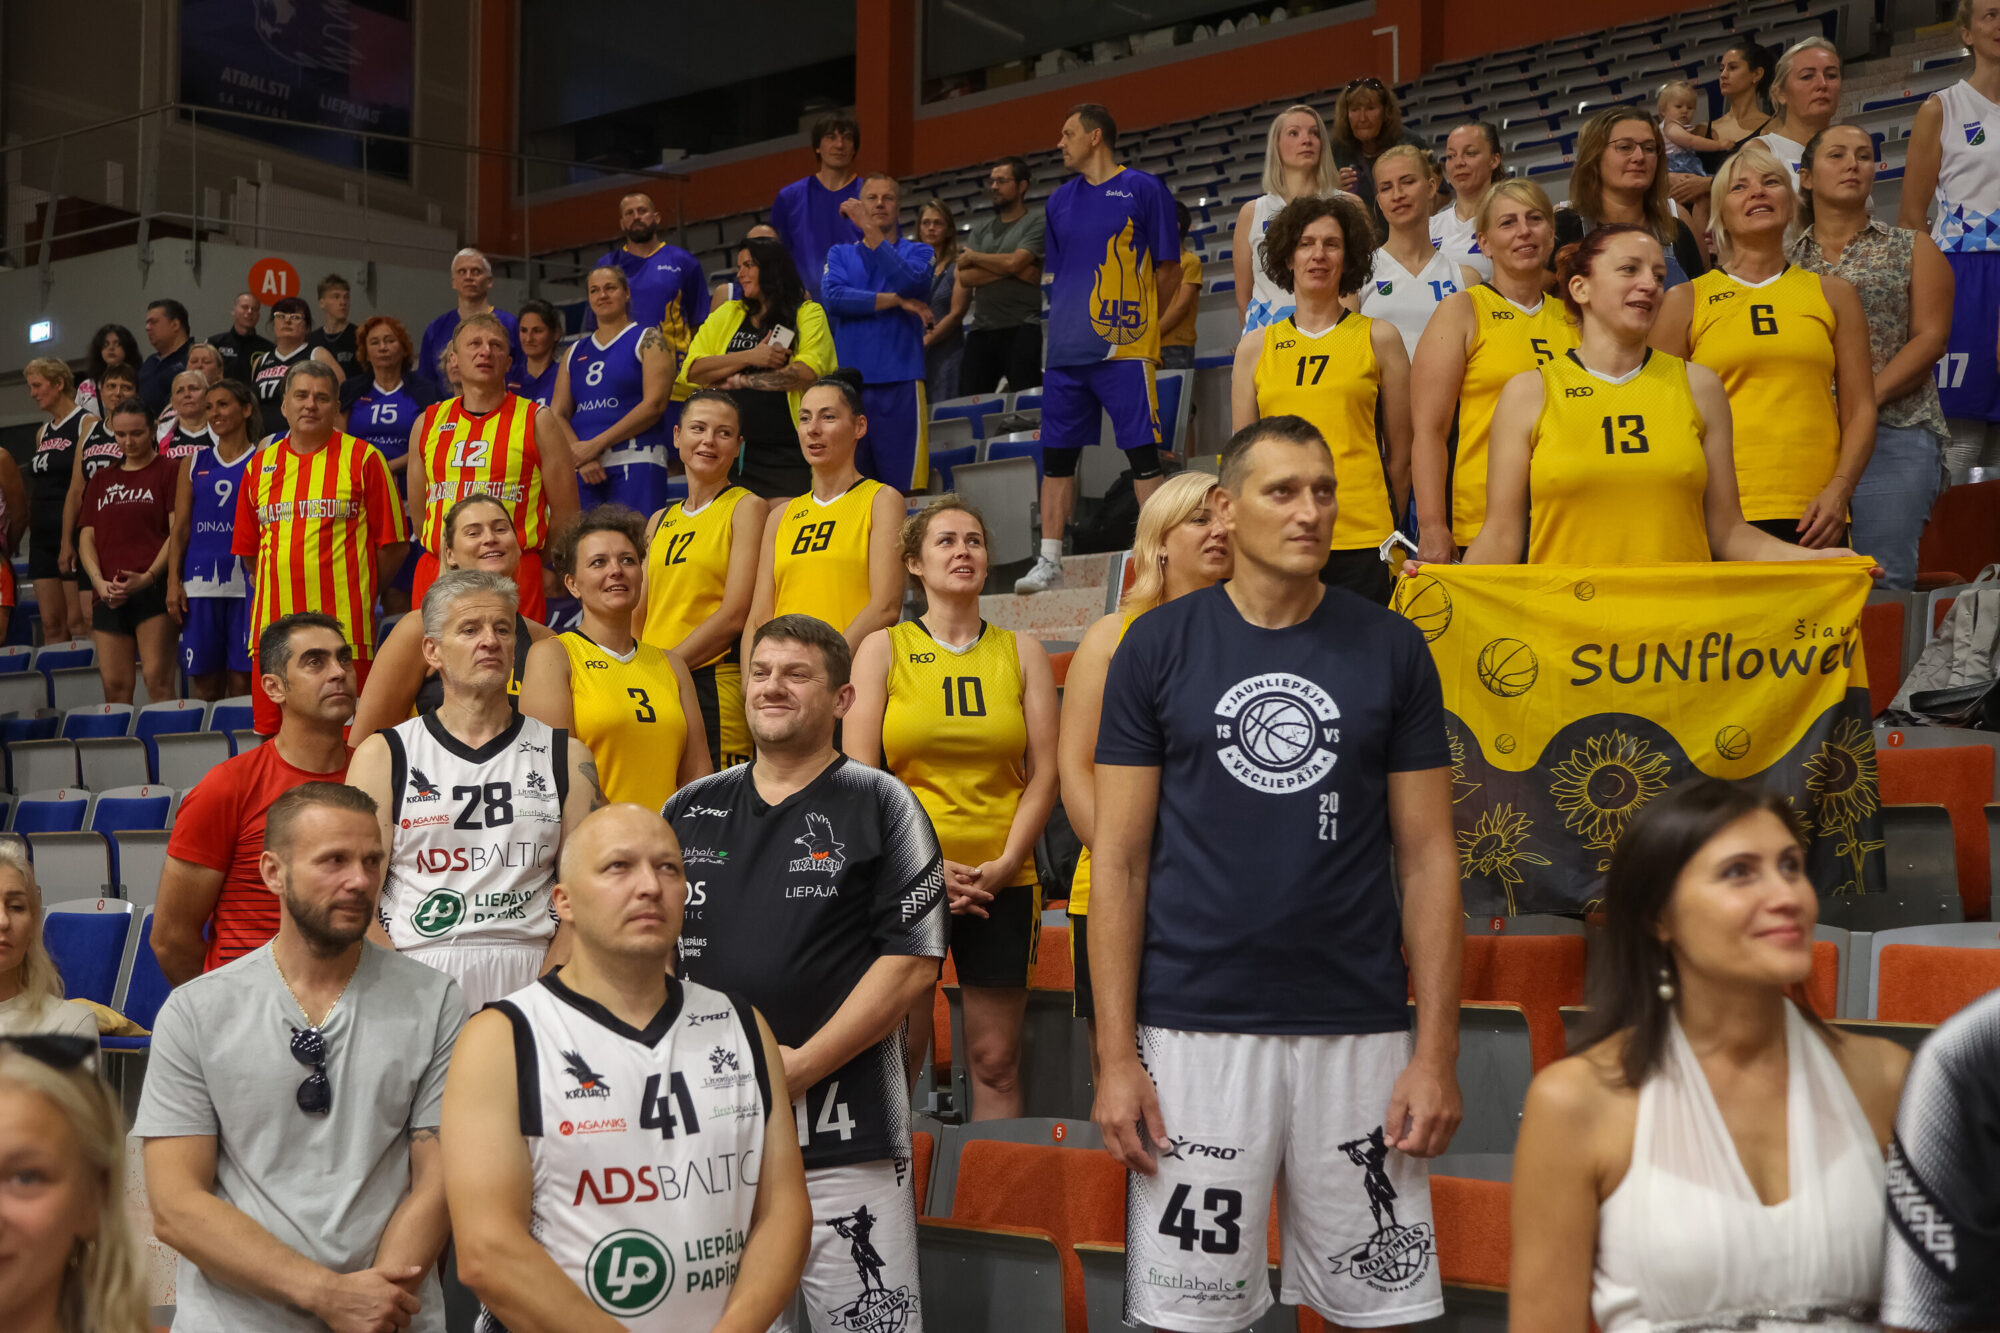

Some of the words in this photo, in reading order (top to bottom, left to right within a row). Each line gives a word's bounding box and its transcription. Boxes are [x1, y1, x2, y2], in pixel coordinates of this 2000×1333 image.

[262, 269, 287, 296] A1
[1098, 299, 1141, 329] 45
[1750, 304, 1778, 335] 6
[1530, 338, 1554, 366] 5
[585, 360, 606, 386] 8
[1296, 355, 1330, 386] 17
[1936, 353, 1969, 388] 17
[258, 380, 280, 400] 17
[370, 403, 398, 425] 15
[576, 397, 619, 413] INAMO
[1601, 415, 1650, 454] 13
[32, 453, 50, 473] 14
[451, 440, 489, 467] 12
[98, 488, 154, 511] LATVIJA
[214, 479, 233, 507] 9
[197, 521, 236, 533] DINAM
[791, 520, 836, 555] 69
[664, 531, 696, 566] 12
[186, 647, 194, 669] 9
[627, 687, 657, 723] 3
[942, 676, 987, 716] 10
[1216, 724, 1232, 739] VS
[1323, 728, 1340, 743] VS
[1233, 759, 1323, 788] VECLIEPĀJA
[452, 781, 514, 830] 28
[1319, 792, 1339, 813] 20
[412, 814, 449, 826] AGAMIKS
[1318, 814, 1337, 840] 21
[785, 886, 839, 899] LIEPĀJA
[639, 1071, 701, 1141] 41
[791, 1080, 856, 1147] 14
[577, 1118, 627, 1131] AGAMIKS
[1158, 1183, 1243, 1255] 43
[685, 1228, 747, 1262] LIEPĀJA
[1358, 1226, 1425, 1275] KOLUMBS
[687, 1261, 740, 1293] PAPĪR
[850, 1290, 905, 1328] KOLUMBS
